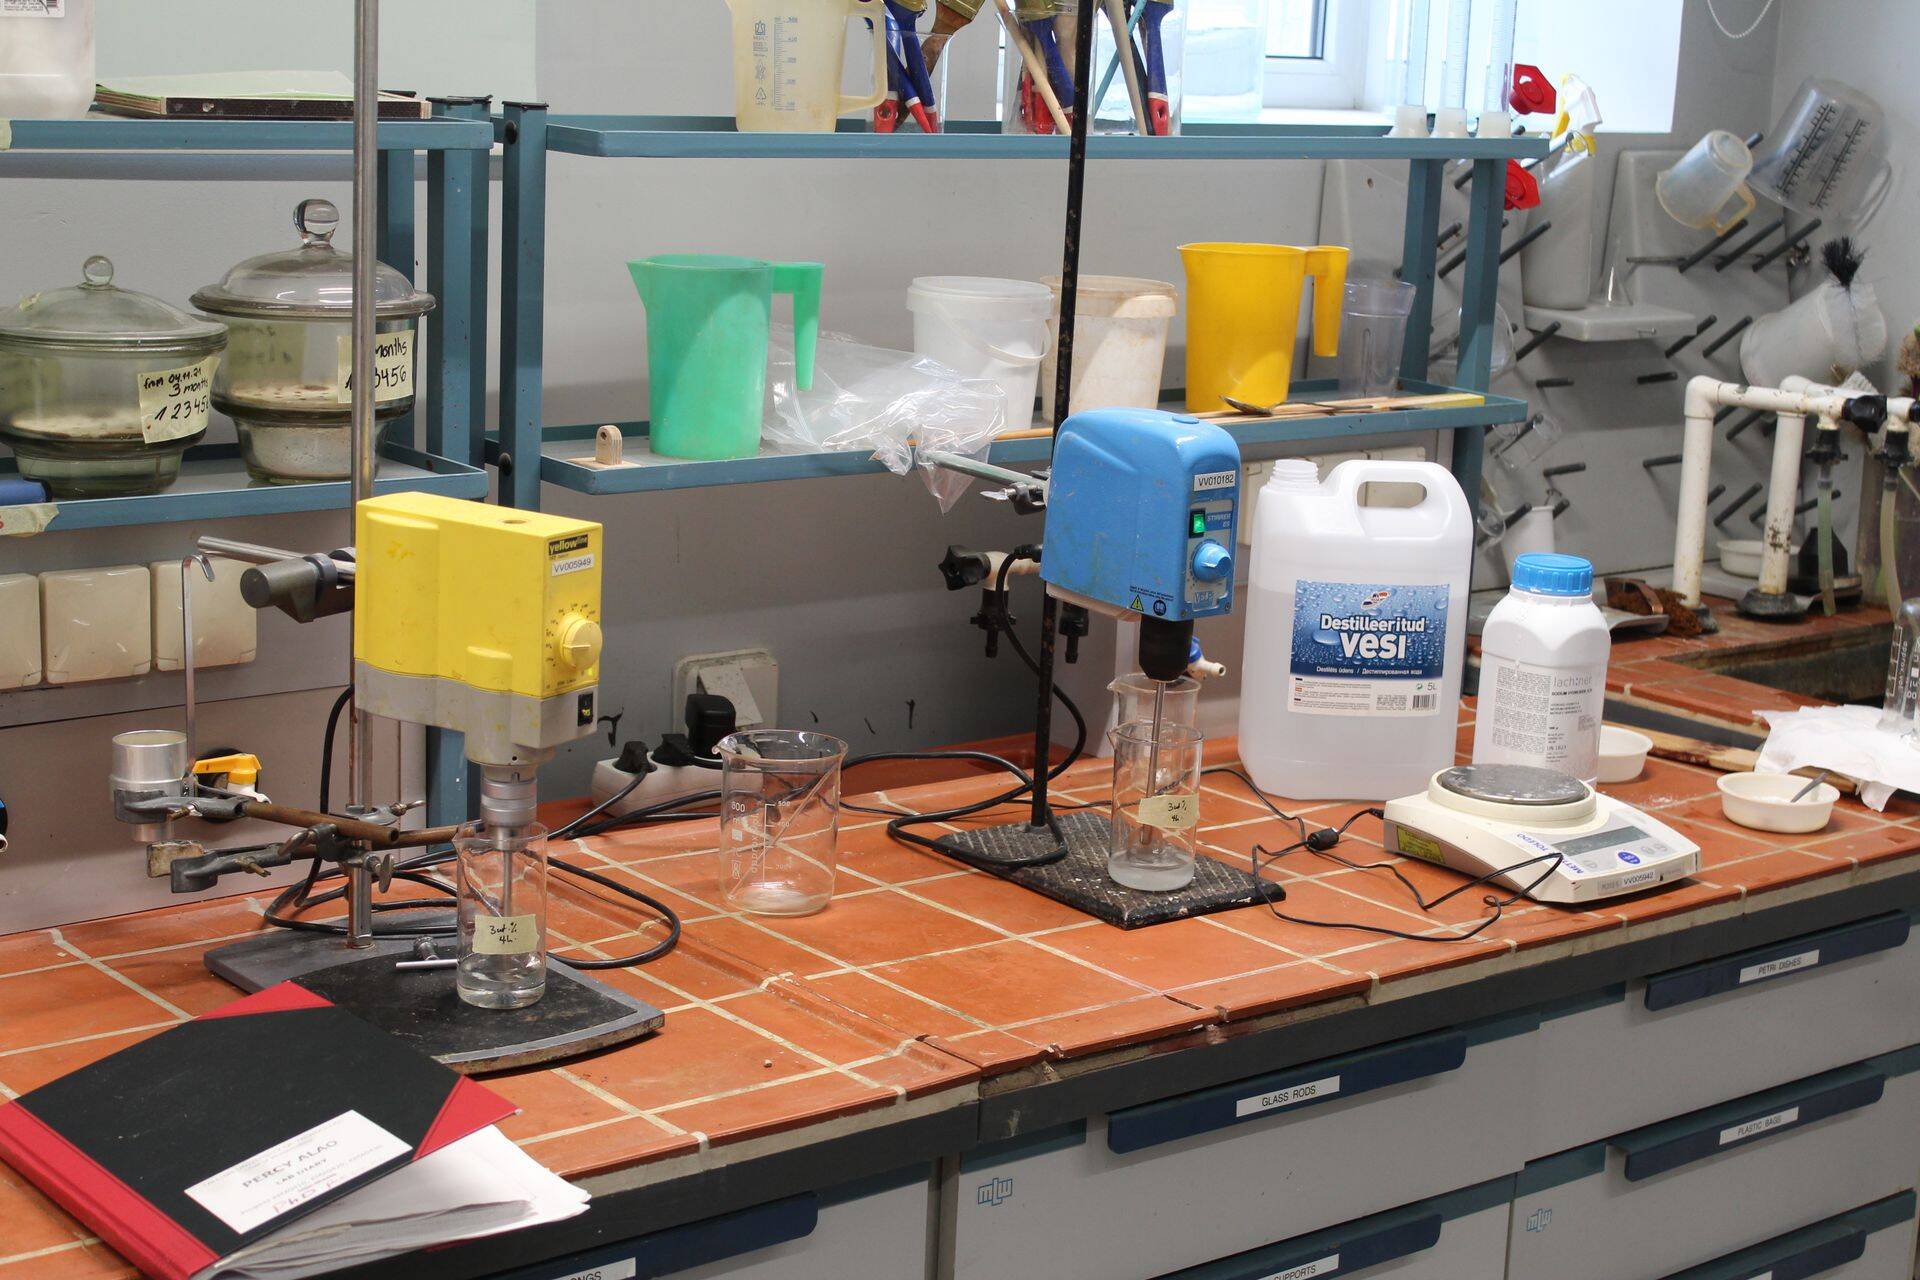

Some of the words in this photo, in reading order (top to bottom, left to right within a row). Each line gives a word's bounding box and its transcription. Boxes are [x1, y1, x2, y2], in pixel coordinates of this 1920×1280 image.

[169, 383, 181, 397] 3
[1198, 474, 1234, 487] VV010182
[554, 557, 592, 573] VV005949
[1320, 613, 1426, 632] Destilleeritud
[1758, 963, 1776, 977] PETRI
[1779, 956, 1802, 971] DISHES
[1261, 1092, 1289, 1107] GLASS
[1292, 1085, 1316, 1100] RODS
[1738, 1121, 1762, 1136] PLASTIC
[242, 1159, 293, 1188] PERCY
[298, 1139, 338, 1162] ALAO
